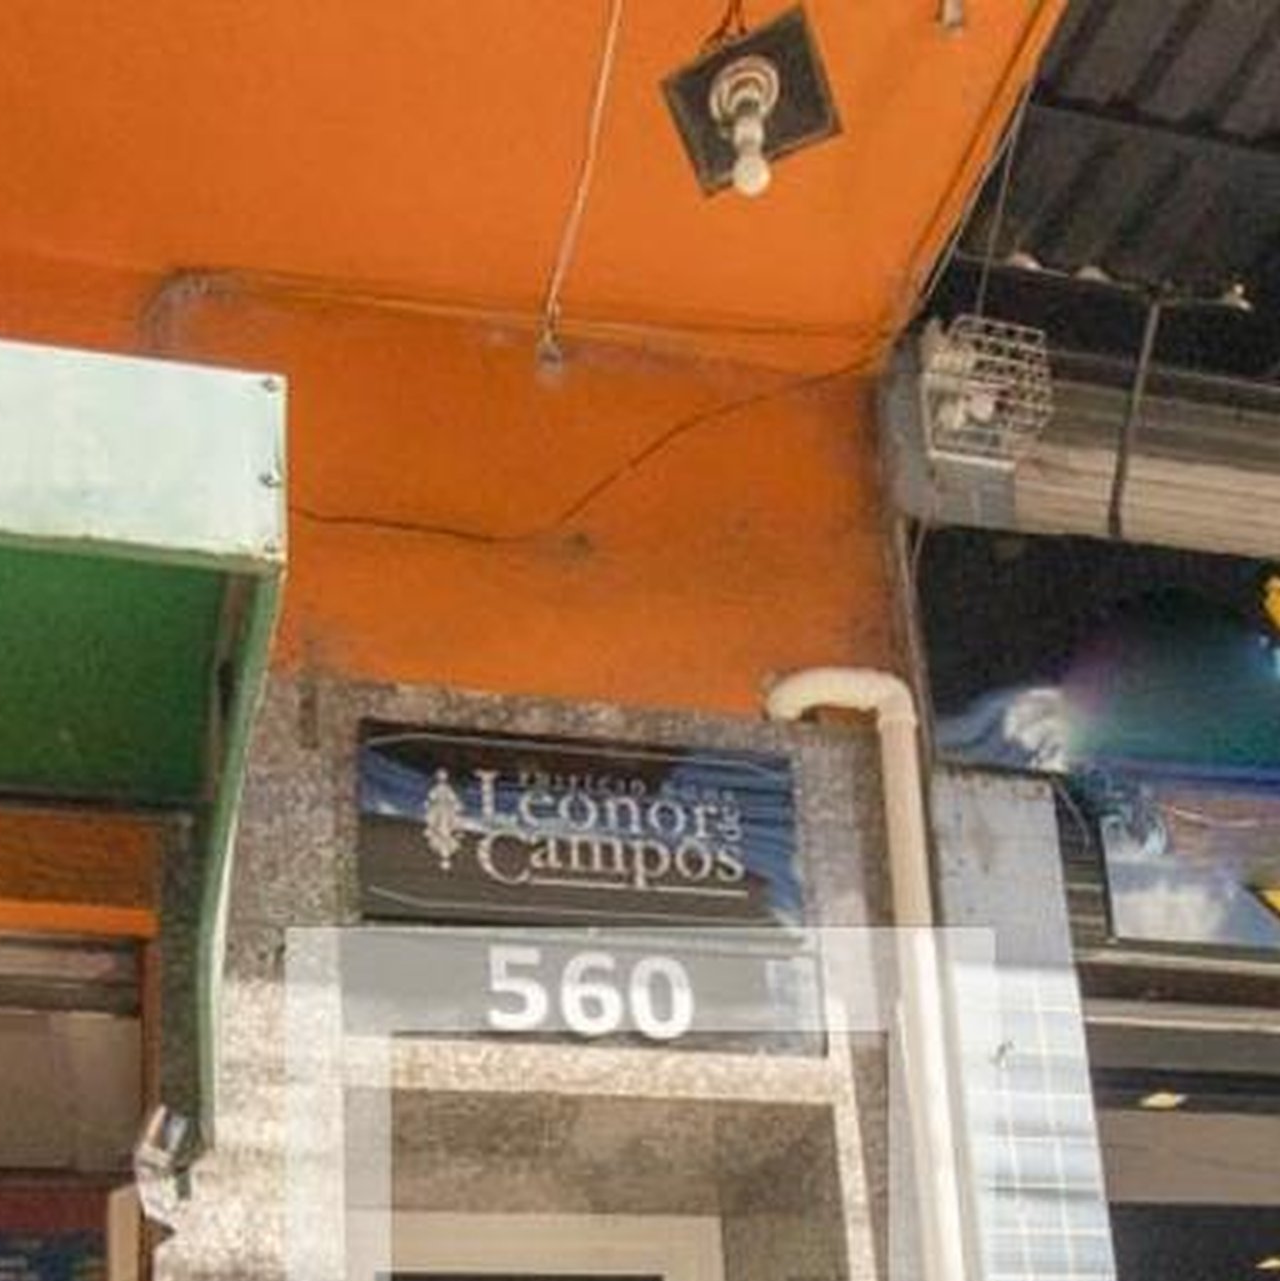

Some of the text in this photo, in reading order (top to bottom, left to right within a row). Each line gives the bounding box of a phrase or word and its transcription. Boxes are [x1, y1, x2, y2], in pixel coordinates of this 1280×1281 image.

[473, 768, 718, 838] Leonor
[477, 831, 747, 890] Campos
[487, 944, 695, 1040] 560
